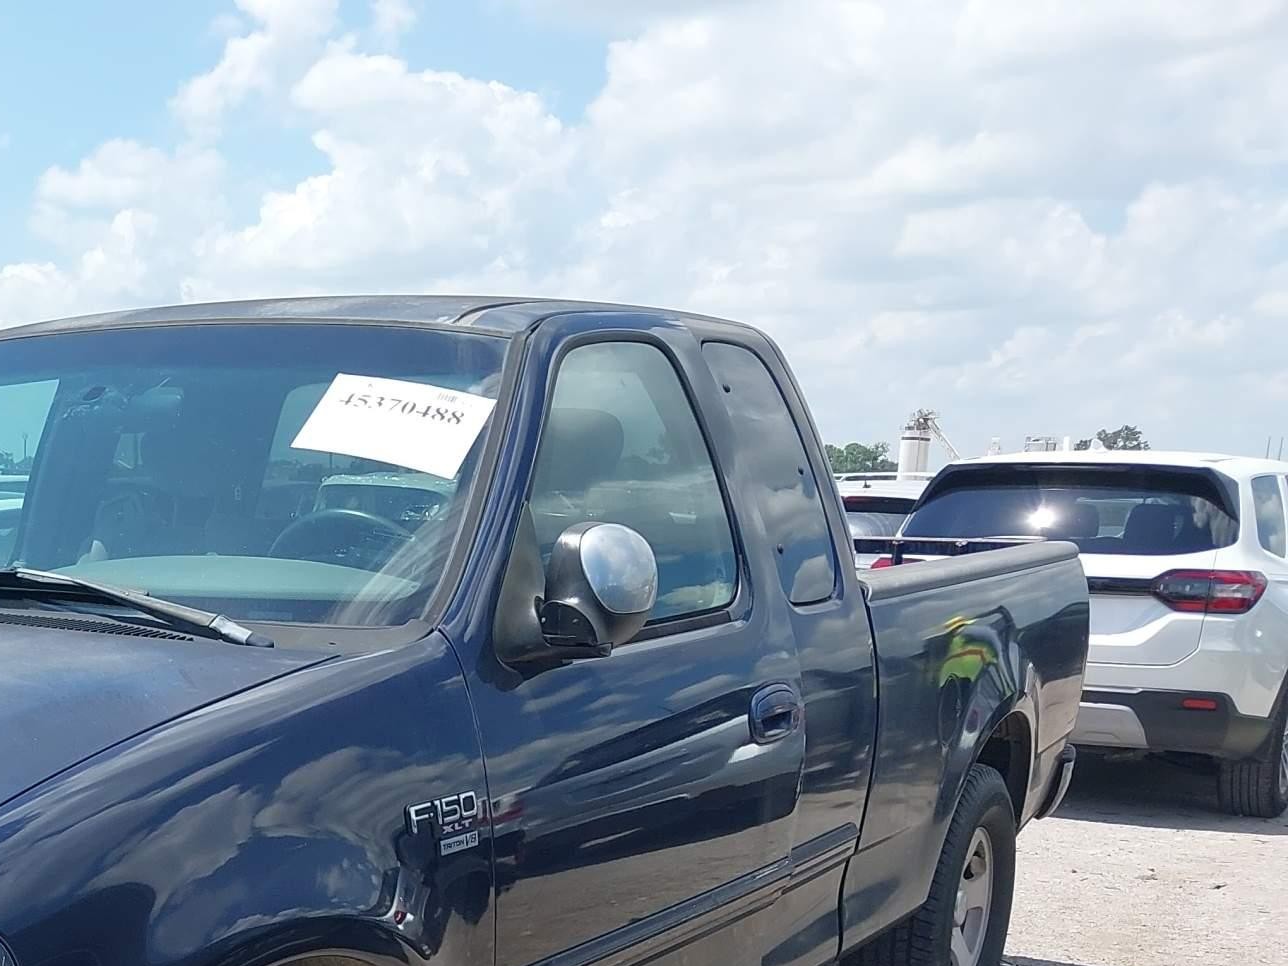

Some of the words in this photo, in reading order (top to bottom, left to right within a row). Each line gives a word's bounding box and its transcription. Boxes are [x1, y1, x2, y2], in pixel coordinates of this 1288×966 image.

[338, 391, 465, 425] 45370488
[442, 819, 473, 834] XLT
[443, 839, 465, 851] TRITON
[466, 833, 478, 847] V8
